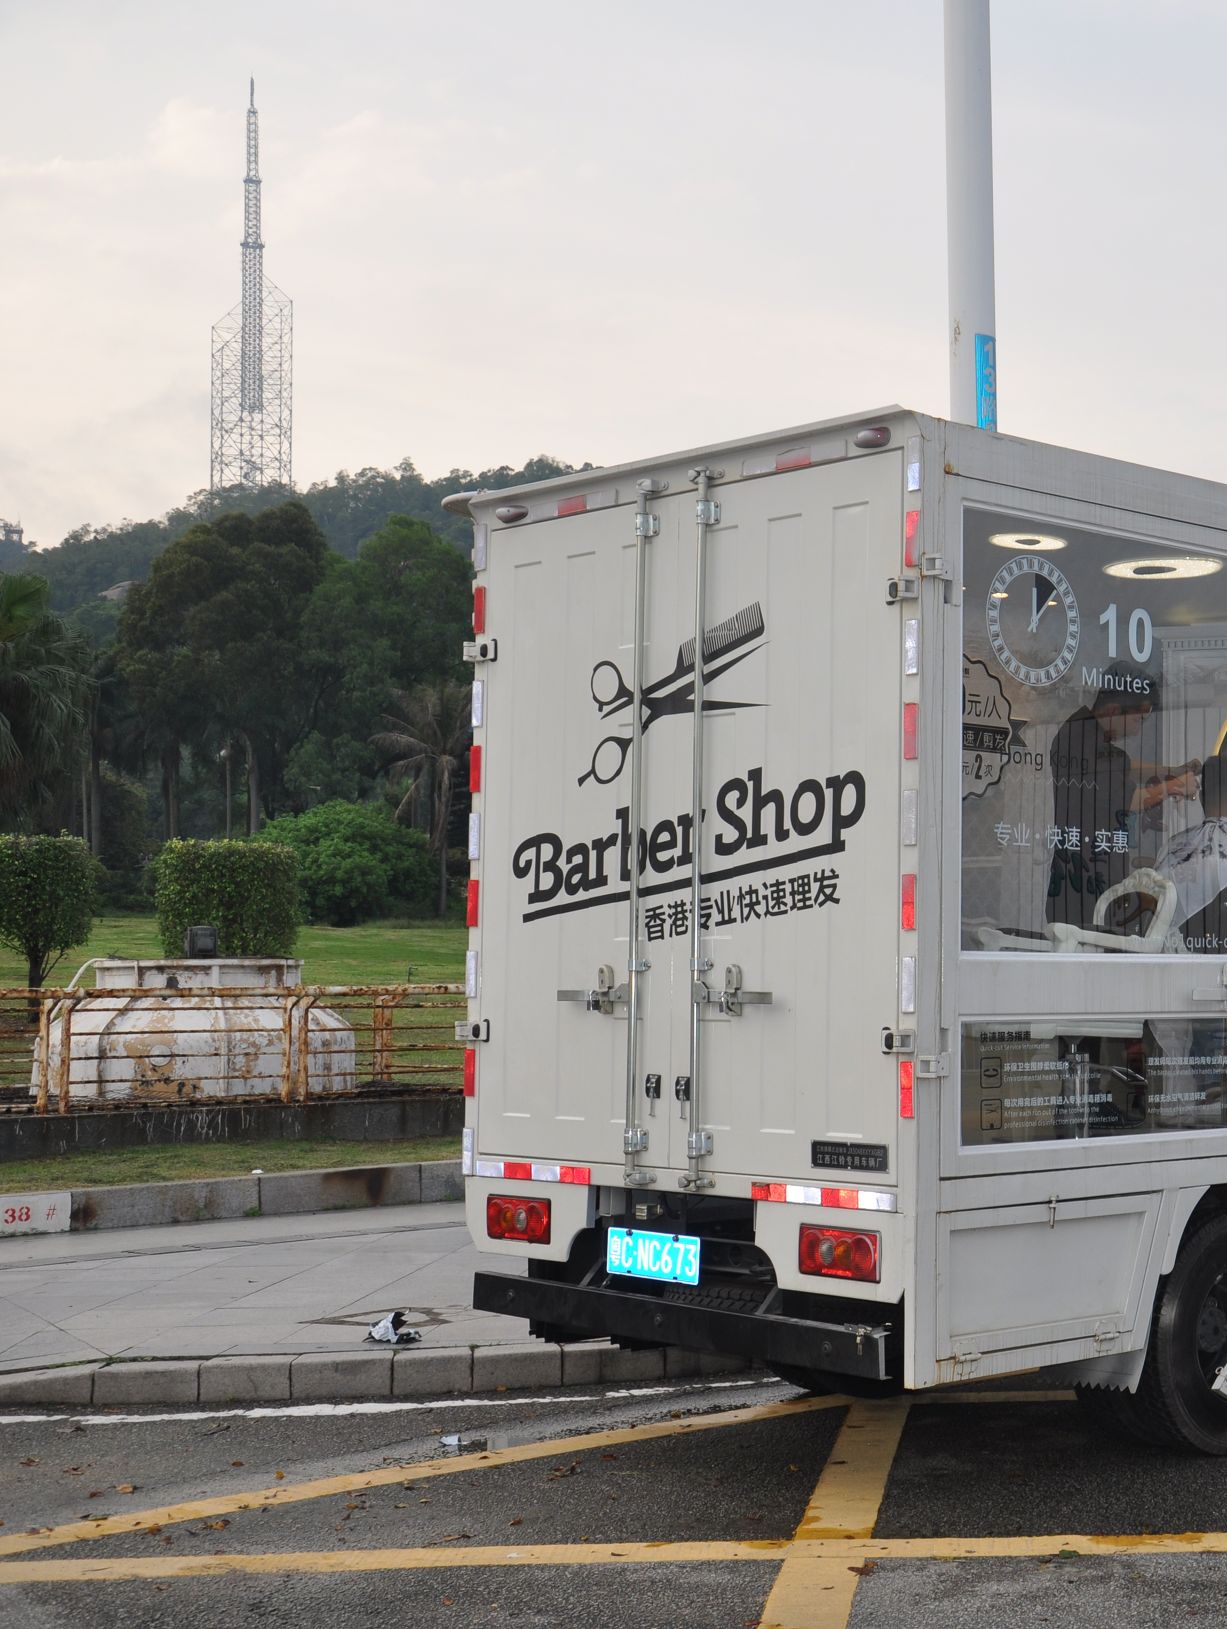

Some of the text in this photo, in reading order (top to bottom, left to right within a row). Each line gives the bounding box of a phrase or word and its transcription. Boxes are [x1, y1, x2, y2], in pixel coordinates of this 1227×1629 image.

[1099, 603, 1153, 663] 10
[1082, 665, 1151, 695] Minutes
[962, 688, 1003, 720] 元/人
[1050, 750, 1089, 774] Kong
[512, 766, 866, 905] Barber Shop
[644, 868, 841, 942] 香港专业快速理发
[4, 1205, 31, 1225] 38
